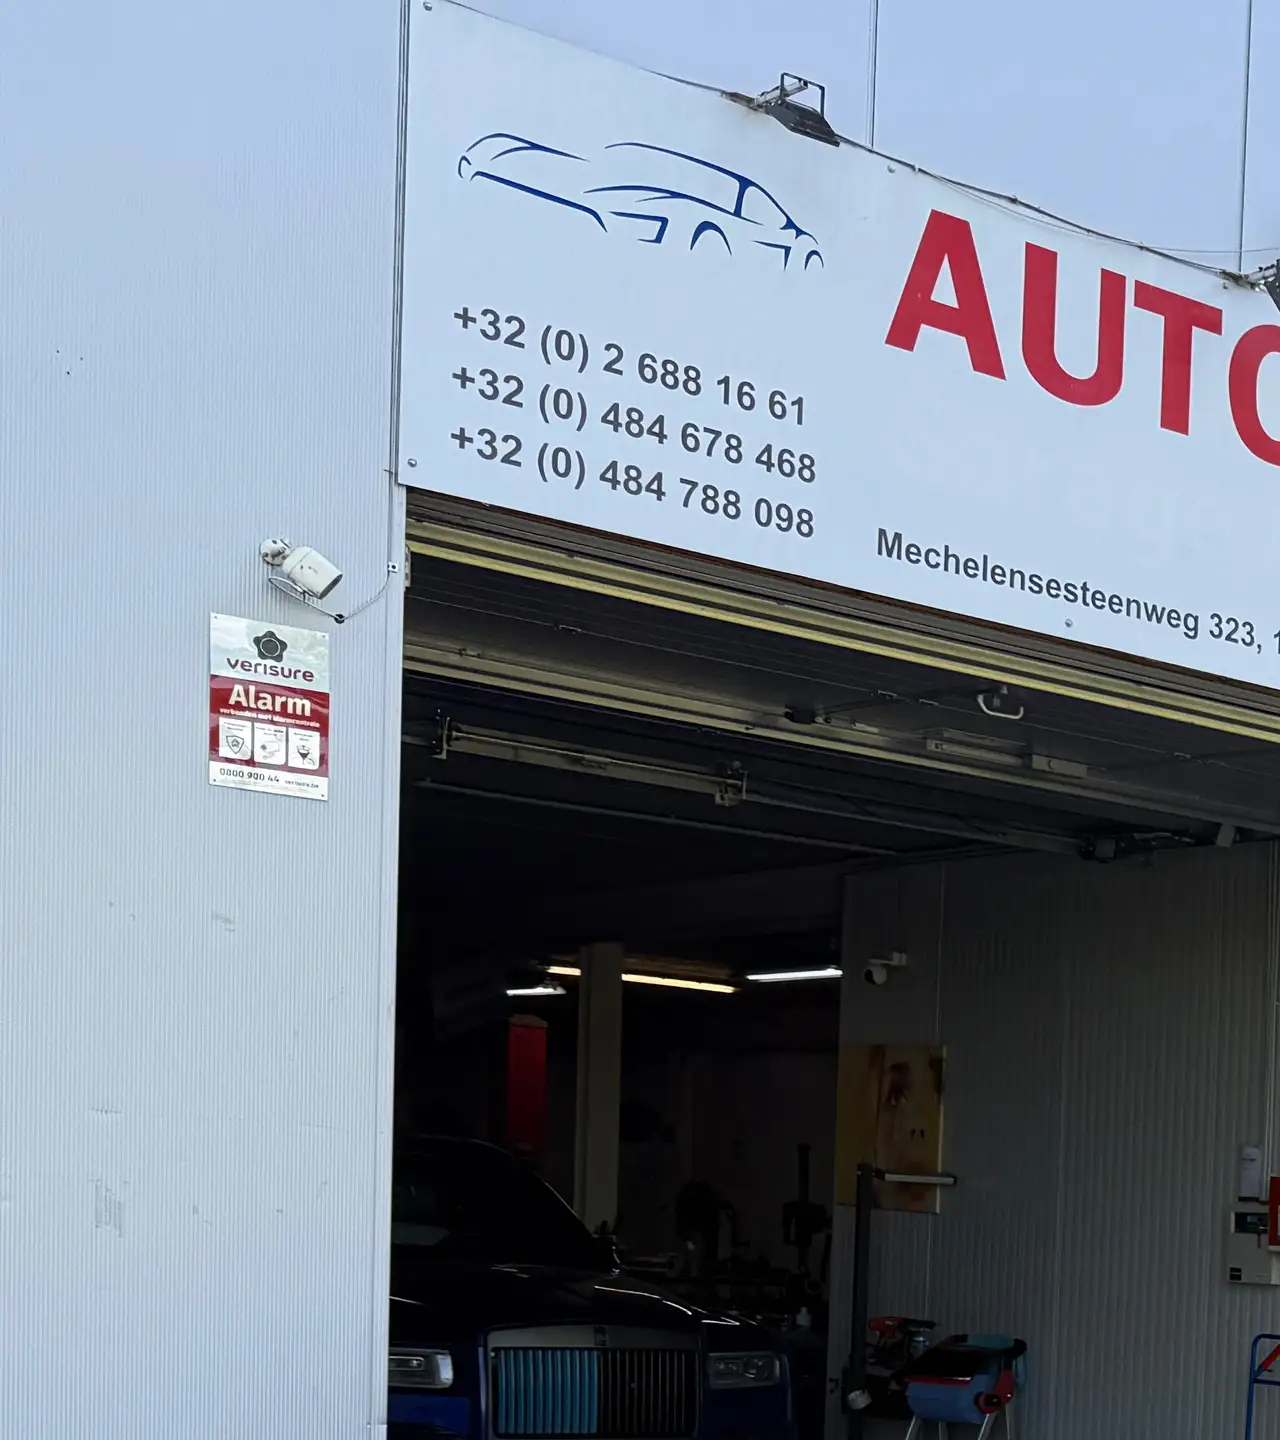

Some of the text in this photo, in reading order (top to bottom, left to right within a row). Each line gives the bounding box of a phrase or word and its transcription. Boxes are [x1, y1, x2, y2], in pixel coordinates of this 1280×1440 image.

[453, 306, 804, 426] +32 (0) 2 688 16 61
[451, 426, 814, 539] +32 (0) 484 788 098
[452, 366, 816, 484] +32 (0) 484 678 468
[876, 527, 1200, 640] Mechelensesteenweg
[1209, 612, 1262, 655] 323,
[226, 657, 315, 682] verisure
[229, 684, 312, 717] Alarm
